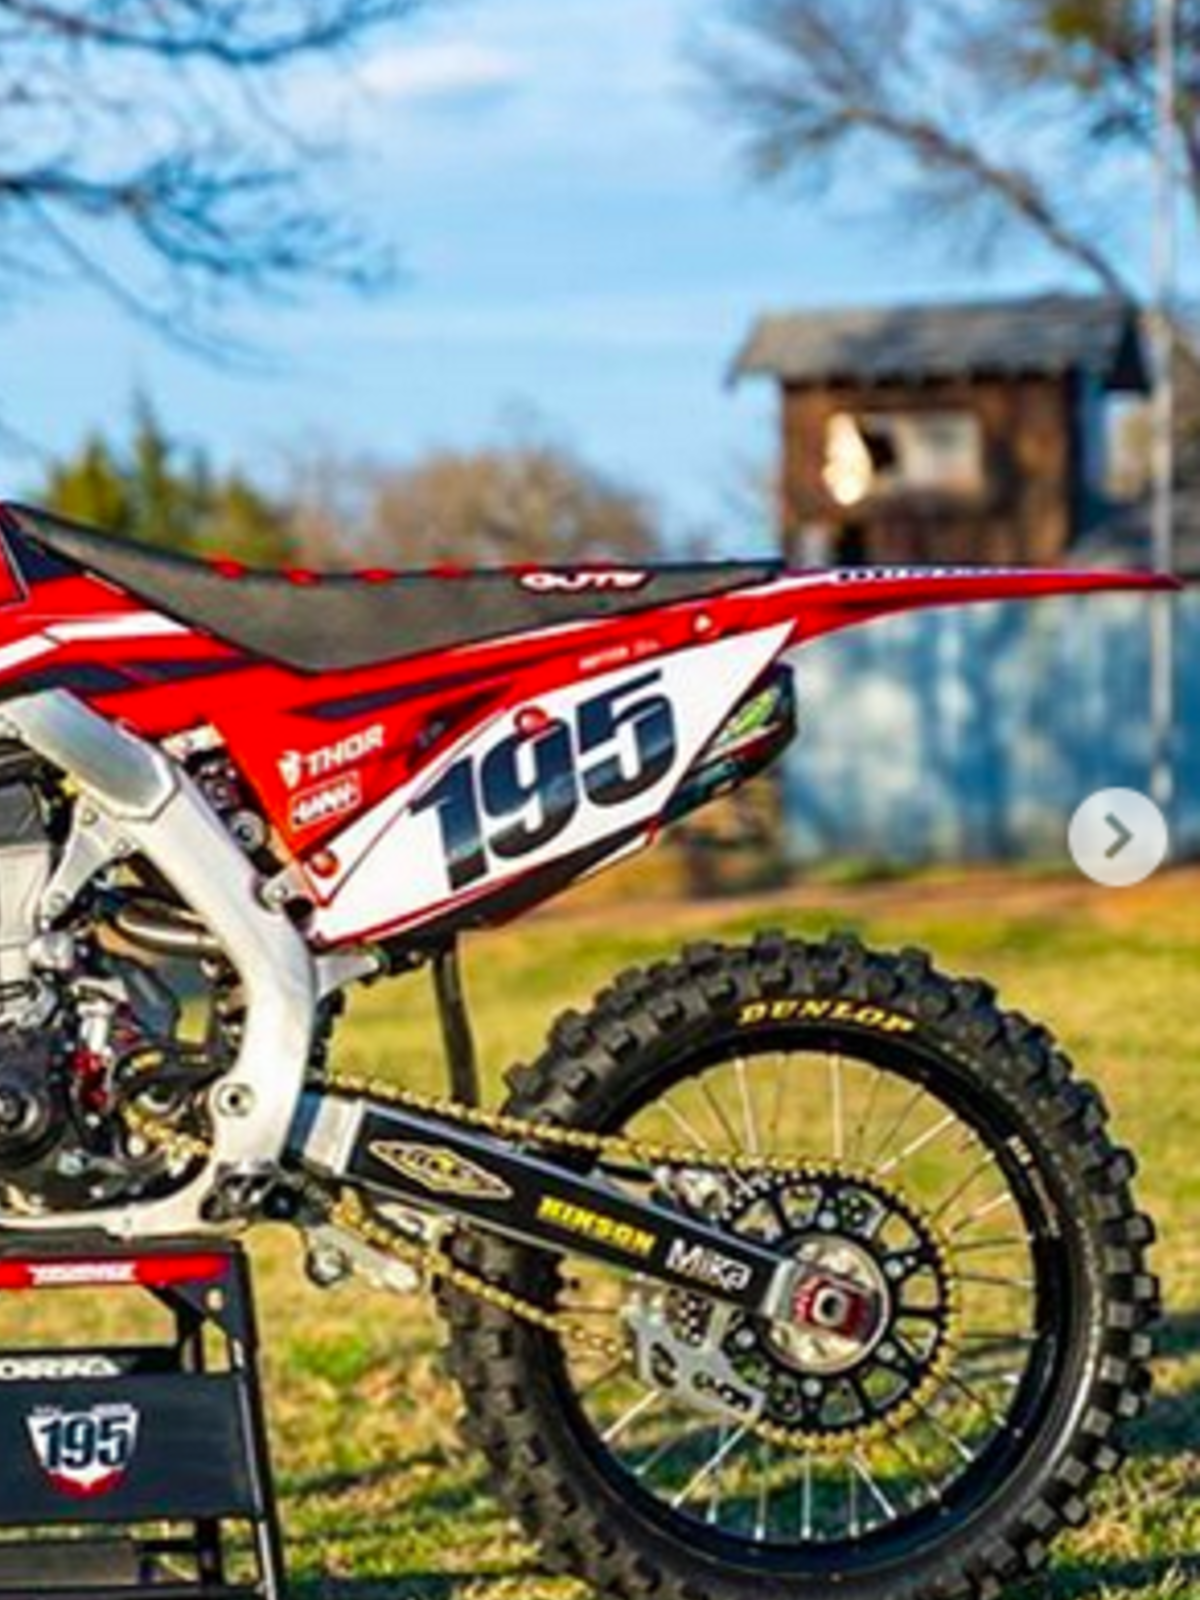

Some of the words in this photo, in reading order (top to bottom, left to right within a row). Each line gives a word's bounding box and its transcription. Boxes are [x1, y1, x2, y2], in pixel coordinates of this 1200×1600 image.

[302, 722, 385, 777] THOR
[407, 668, 677, 890] 195
[738, 1000, 914, 1031] DUNLOP
[40, 1413, 128, 1470] 195
